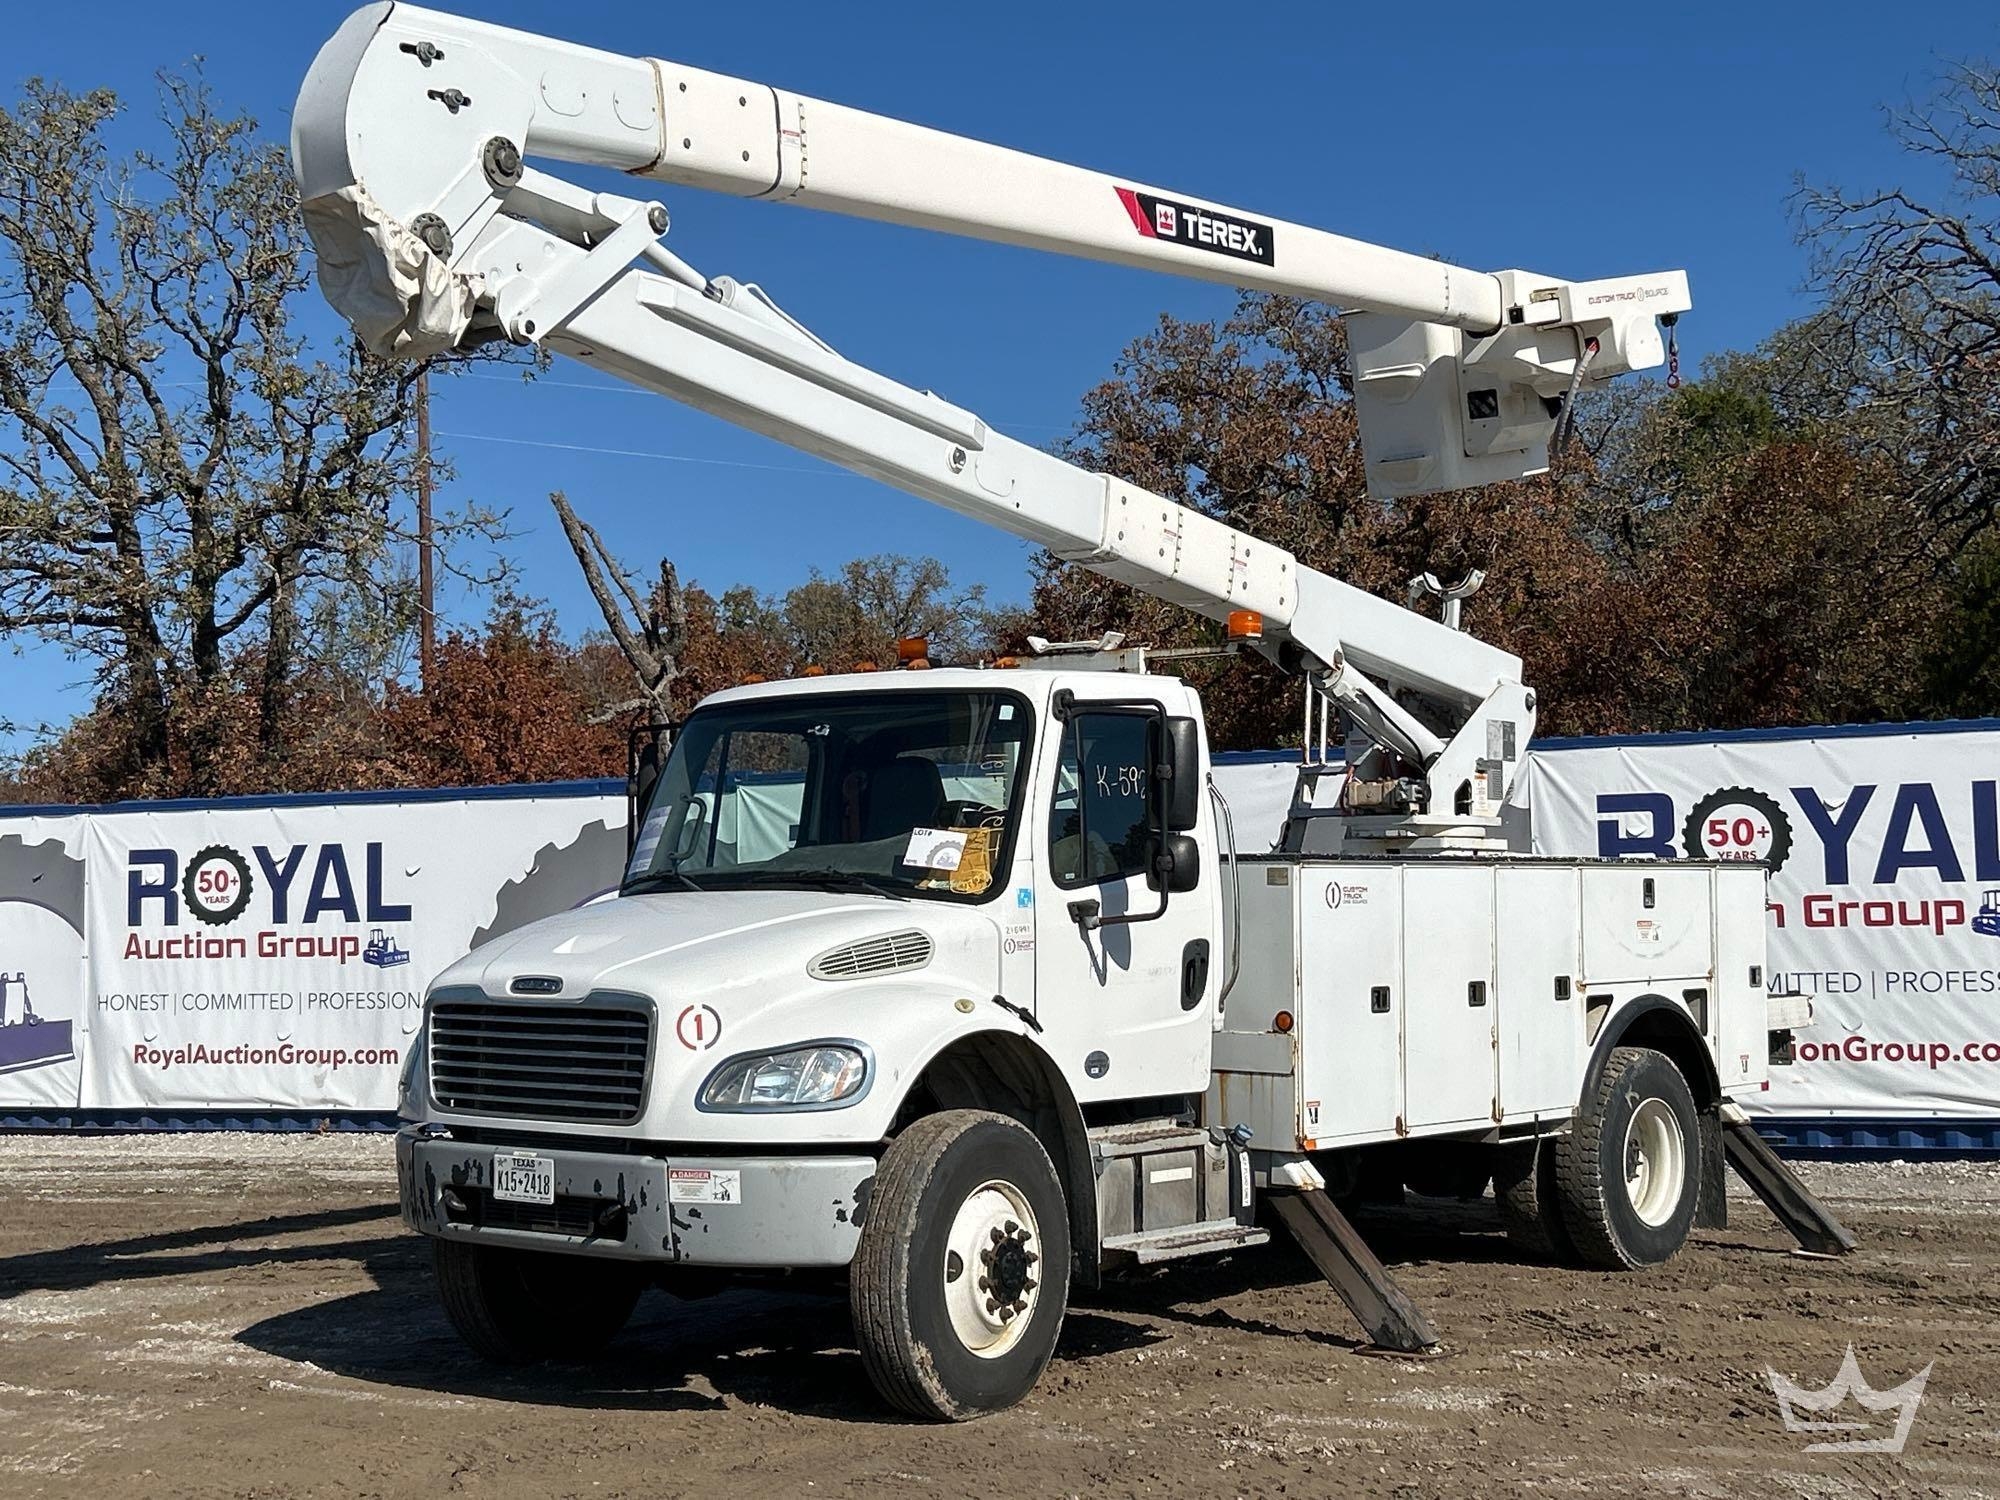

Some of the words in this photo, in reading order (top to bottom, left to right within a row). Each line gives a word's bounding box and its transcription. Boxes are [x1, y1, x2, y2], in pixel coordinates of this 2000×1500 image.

[1707, 818, 1770, 847] 50+
[1717, 850, 1757, 860] YEARS
[128, 842, 412, 926] ROYAL
[198, 870, 239, 893] 50+
[204, 895, 230, 904] YEARS
[1803, 894, 1965, 935] Group
[124, 931, 246, 960] Auction
[258, 931, 360, 965] Group
[1886, 970, 2000, 992] PROFES
[98, 994, 169, 1011] HONEST
[182, 992, 293, 1011] COMMITTED
[308, 991, 424, 1010] PROFESSION
[134, 1043, 399, 1069] RoyalAuctionGroup.com
[511, 1158, 535, 1168] TEXAS
[678, 1171, 709, 1179] DANGER
